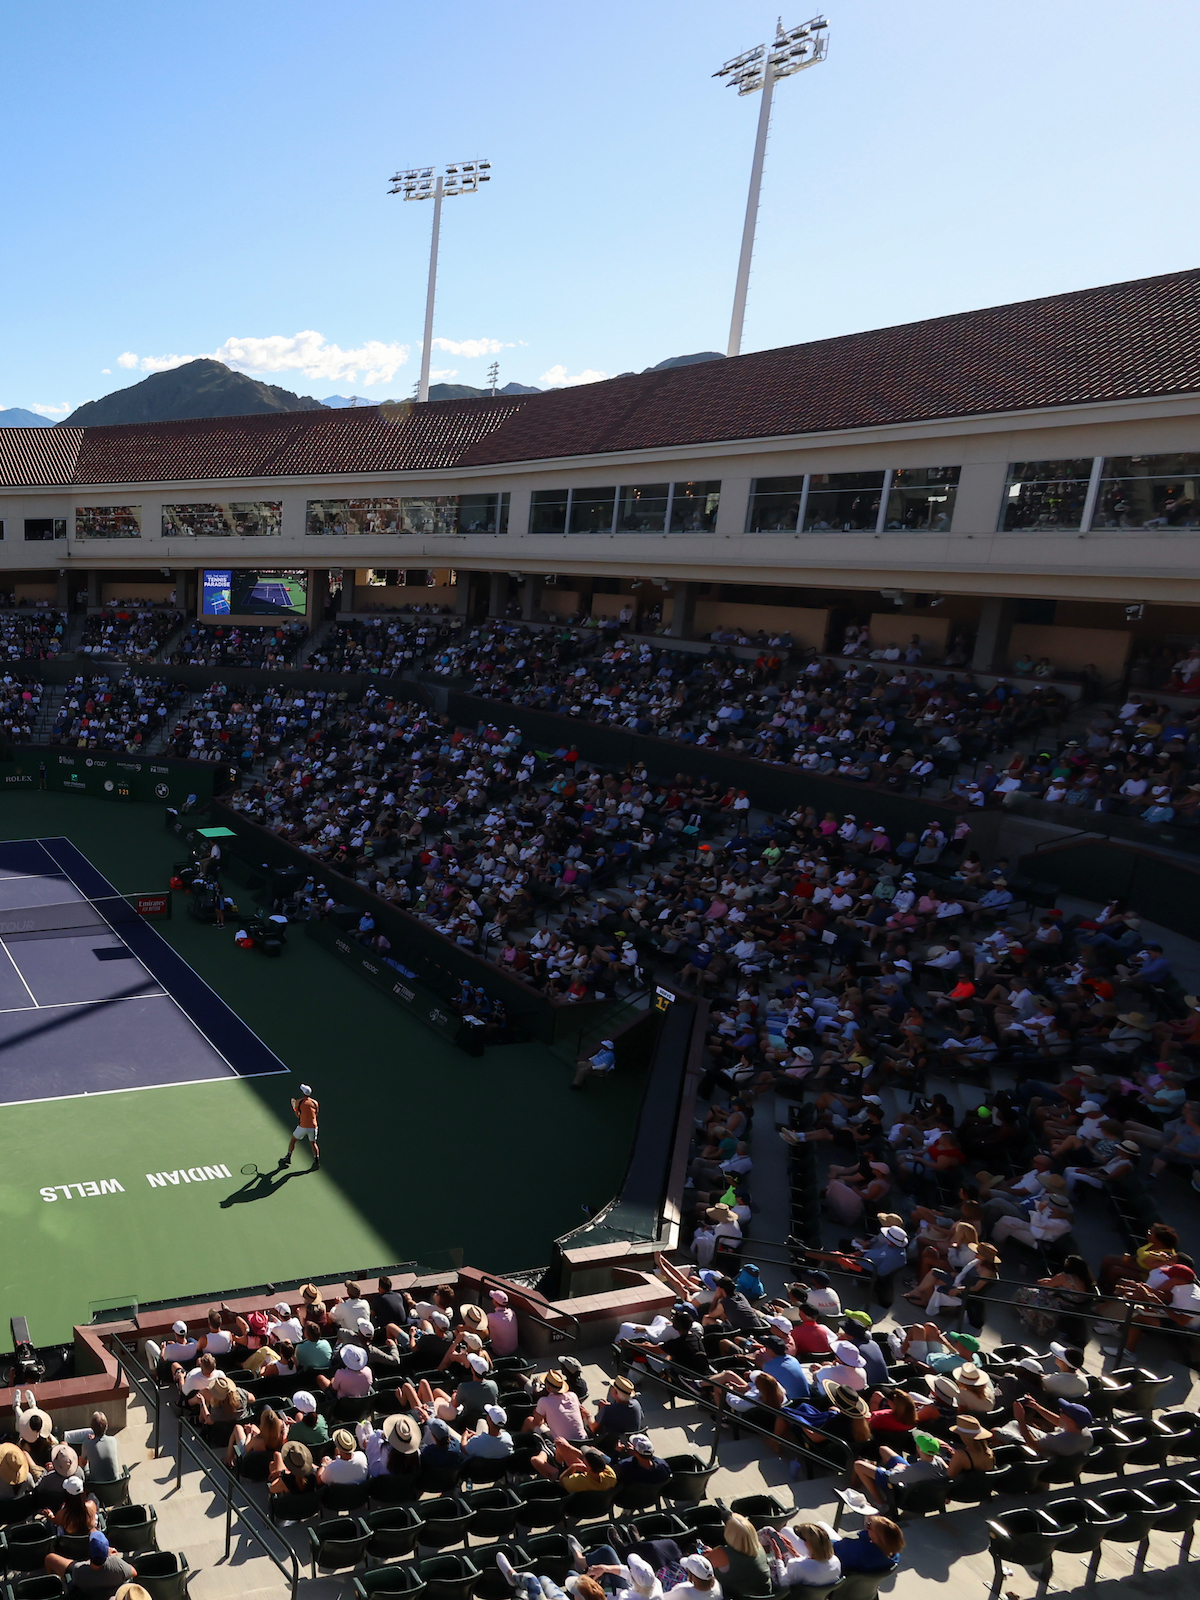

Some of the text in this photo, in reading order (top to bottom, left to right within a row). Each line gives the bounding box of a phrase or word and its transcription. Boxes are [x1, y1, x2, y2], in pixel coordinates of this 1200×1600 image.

[0, 920, 36, 932] TOUR
[362, 960, 379, 975] HOLOGIC
[39, 1164, 233, 1202] INDIAN WELLS
